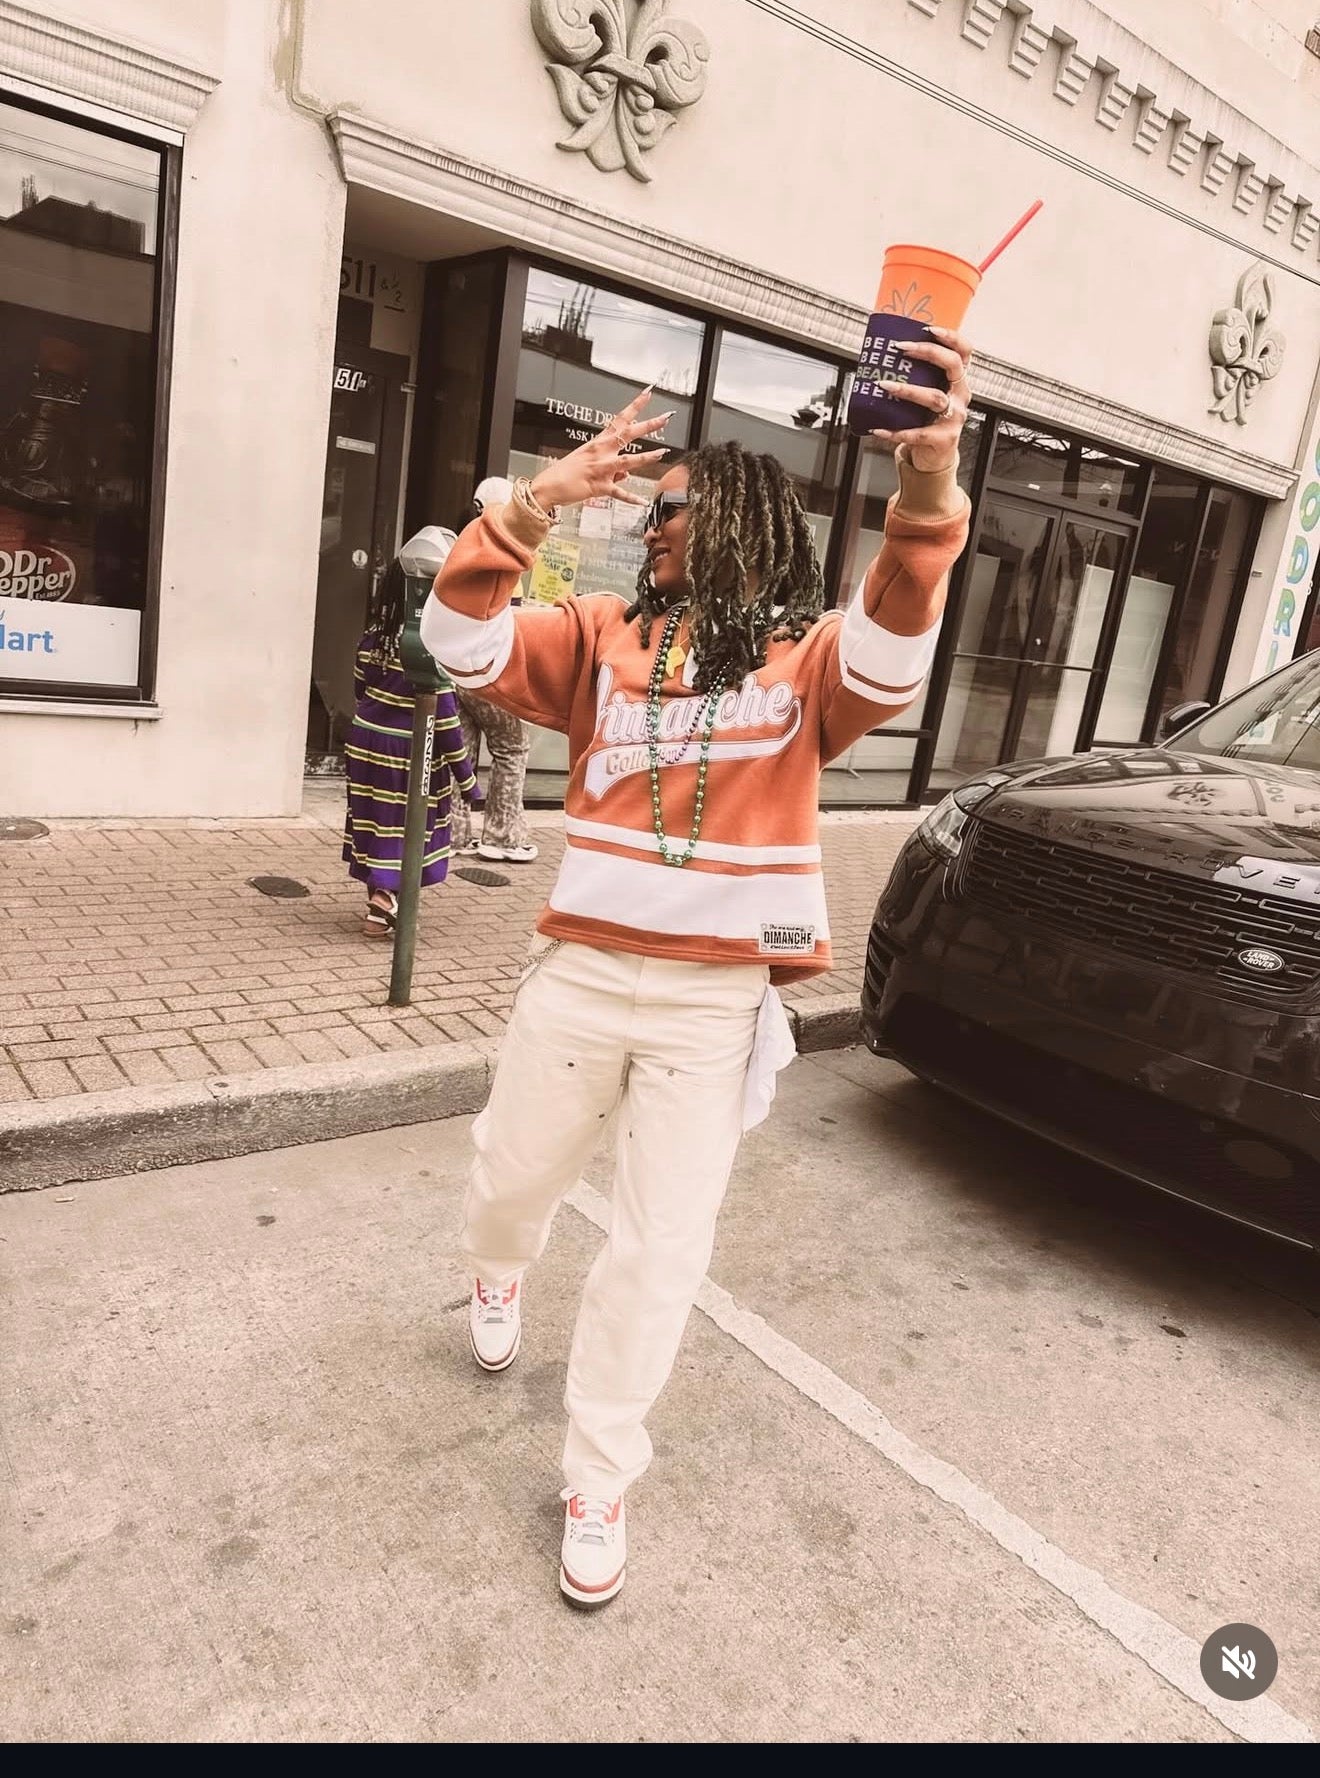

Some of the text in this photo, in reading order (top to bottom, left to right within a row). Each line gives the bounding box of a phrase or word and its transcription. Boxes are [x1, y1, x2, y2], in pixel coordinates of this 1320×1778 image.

[860, 352, 913, 373] BEER
[545, 398, 592, 425] TECHE
[13, 550, 52, 576] Dr
[1163, 850, 1320, 896] ROVE
[764, 931, 812, 944] DIMANCHE
[1247, 951, 1270, 961] LAND
[1247, 958, 1275, 968] ROVER
